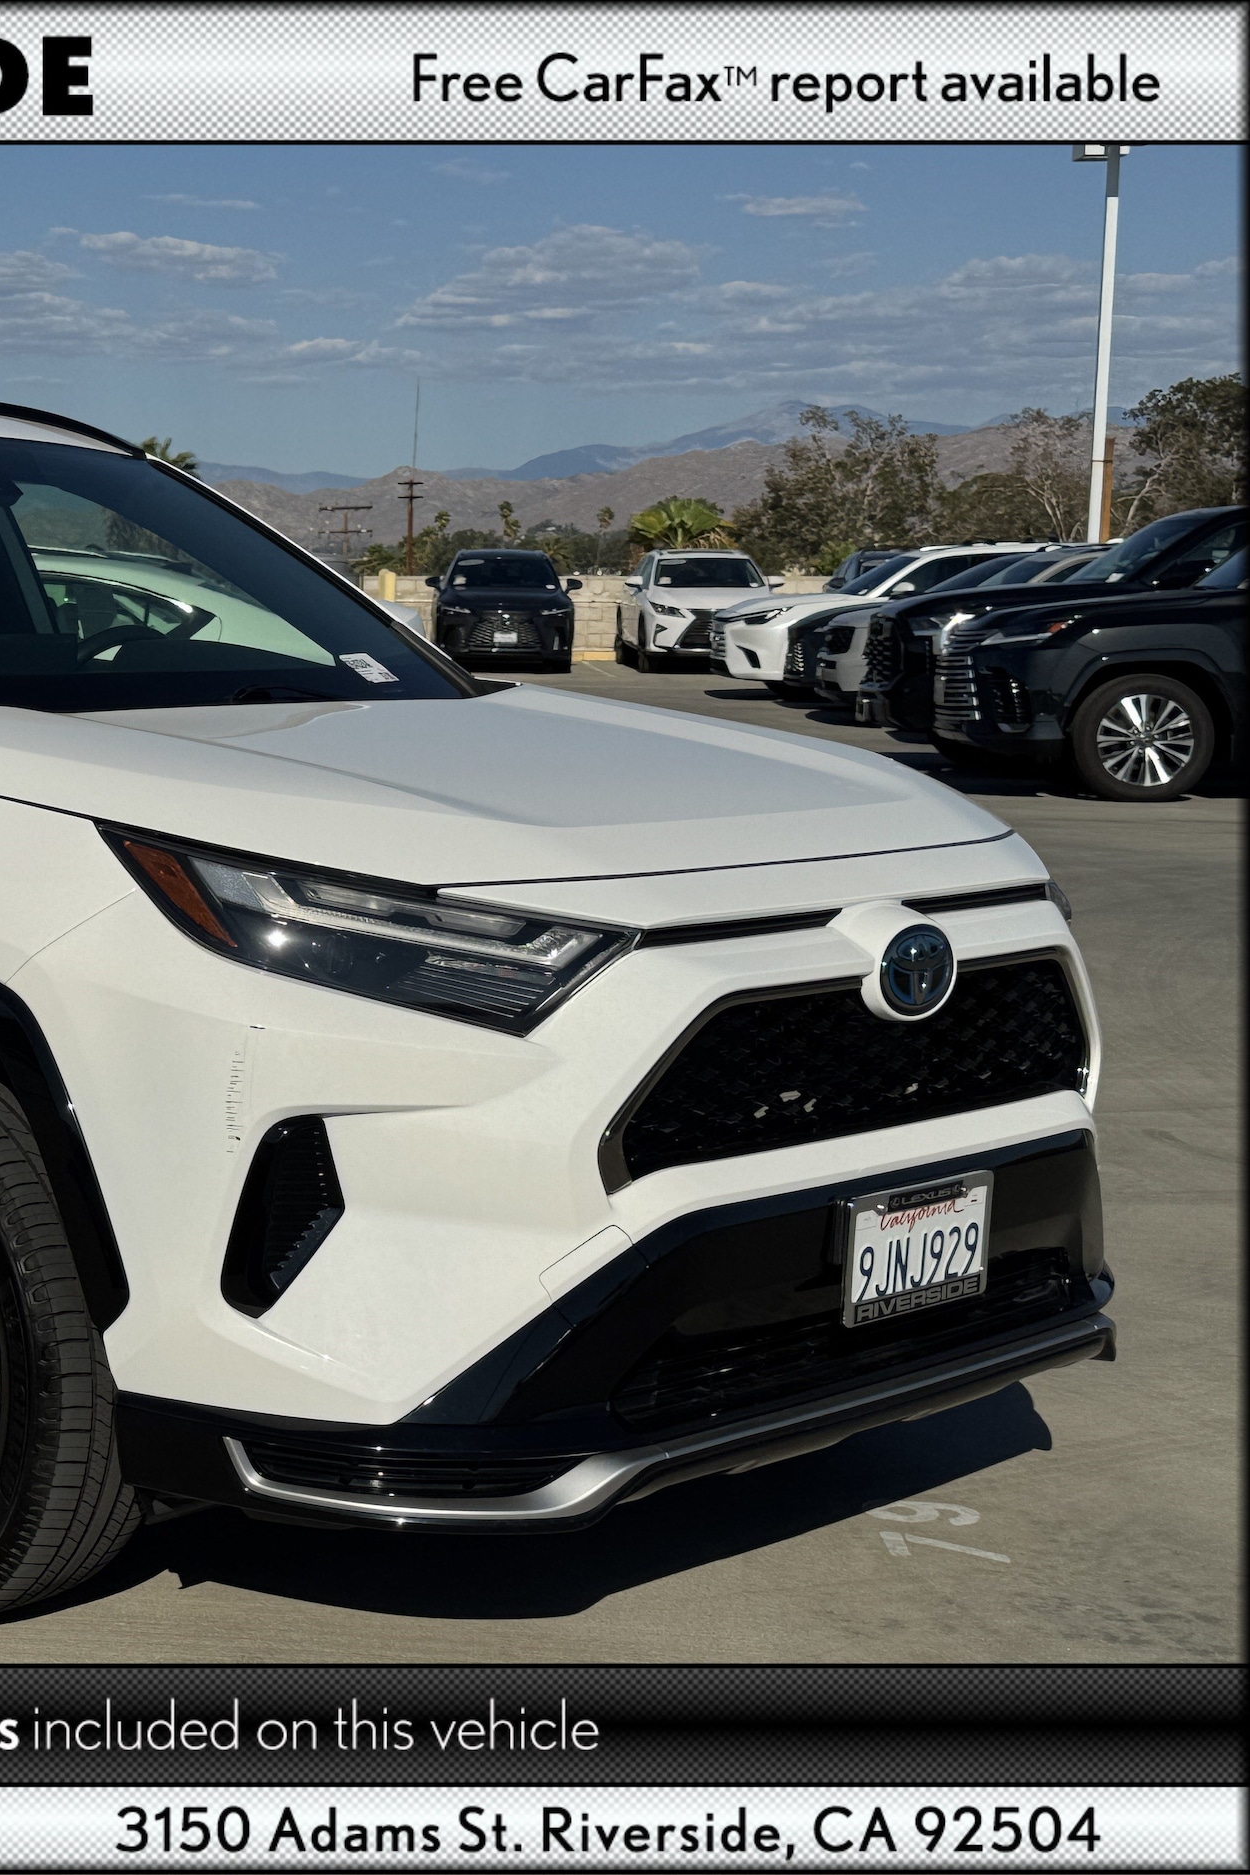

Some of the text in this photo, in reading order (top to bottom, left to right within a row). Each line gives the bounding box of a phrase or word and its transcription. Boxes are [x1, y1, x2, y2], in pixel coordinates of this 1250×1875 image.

[880, 1199, 965, 1233] California
[902, 1186, 952, 1206] LEXUS
[856, 1221, 980, 1301] 9JNJ929
[855, 1276, 979, 1323] RIVERSIDE
